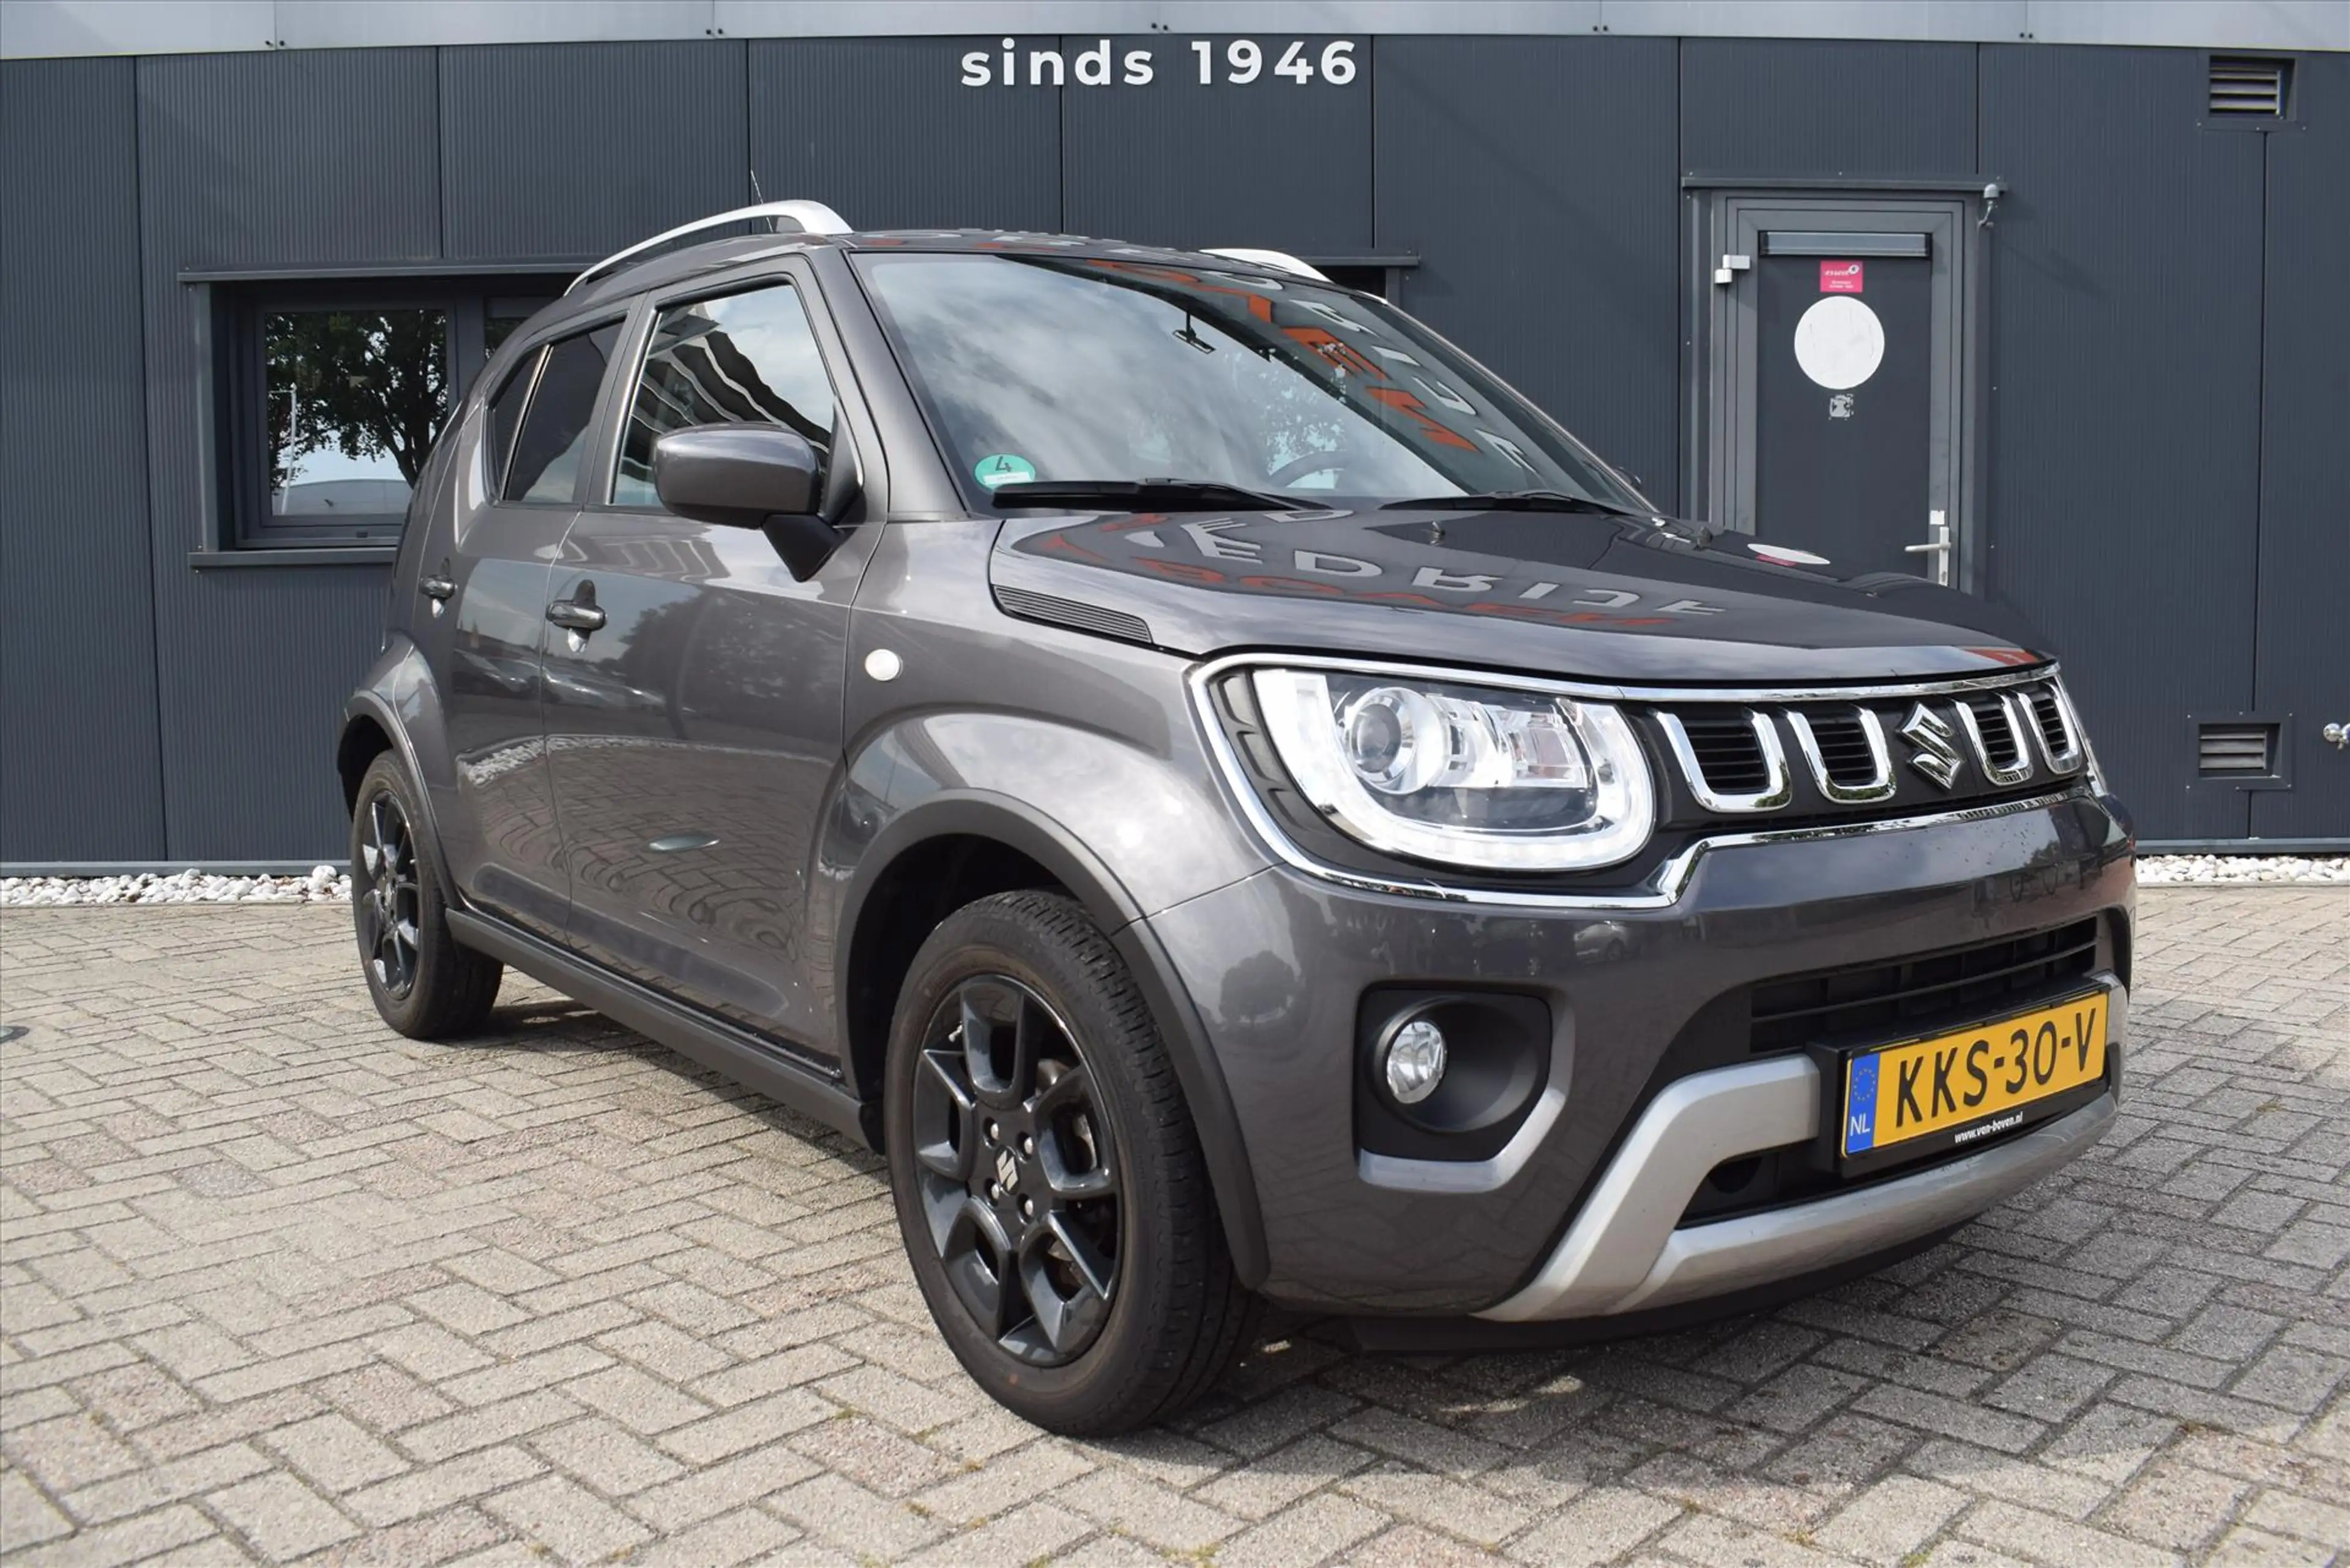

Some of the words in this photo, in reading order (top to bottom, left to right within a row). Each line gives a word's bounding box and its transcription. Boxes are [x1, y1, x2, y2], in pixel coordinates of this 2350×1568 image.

[961, 37, 1154, 86] sinds
[1190, 39, 1357, 85] 1946
[995, 455, 1012, 472] 4
[1896, 1007, 2097, 1127] KKS-30-V
[1849, 1111, 1871, 1137] NL
[1954, 1111, 2023, 1144] www.van-boven.nl
